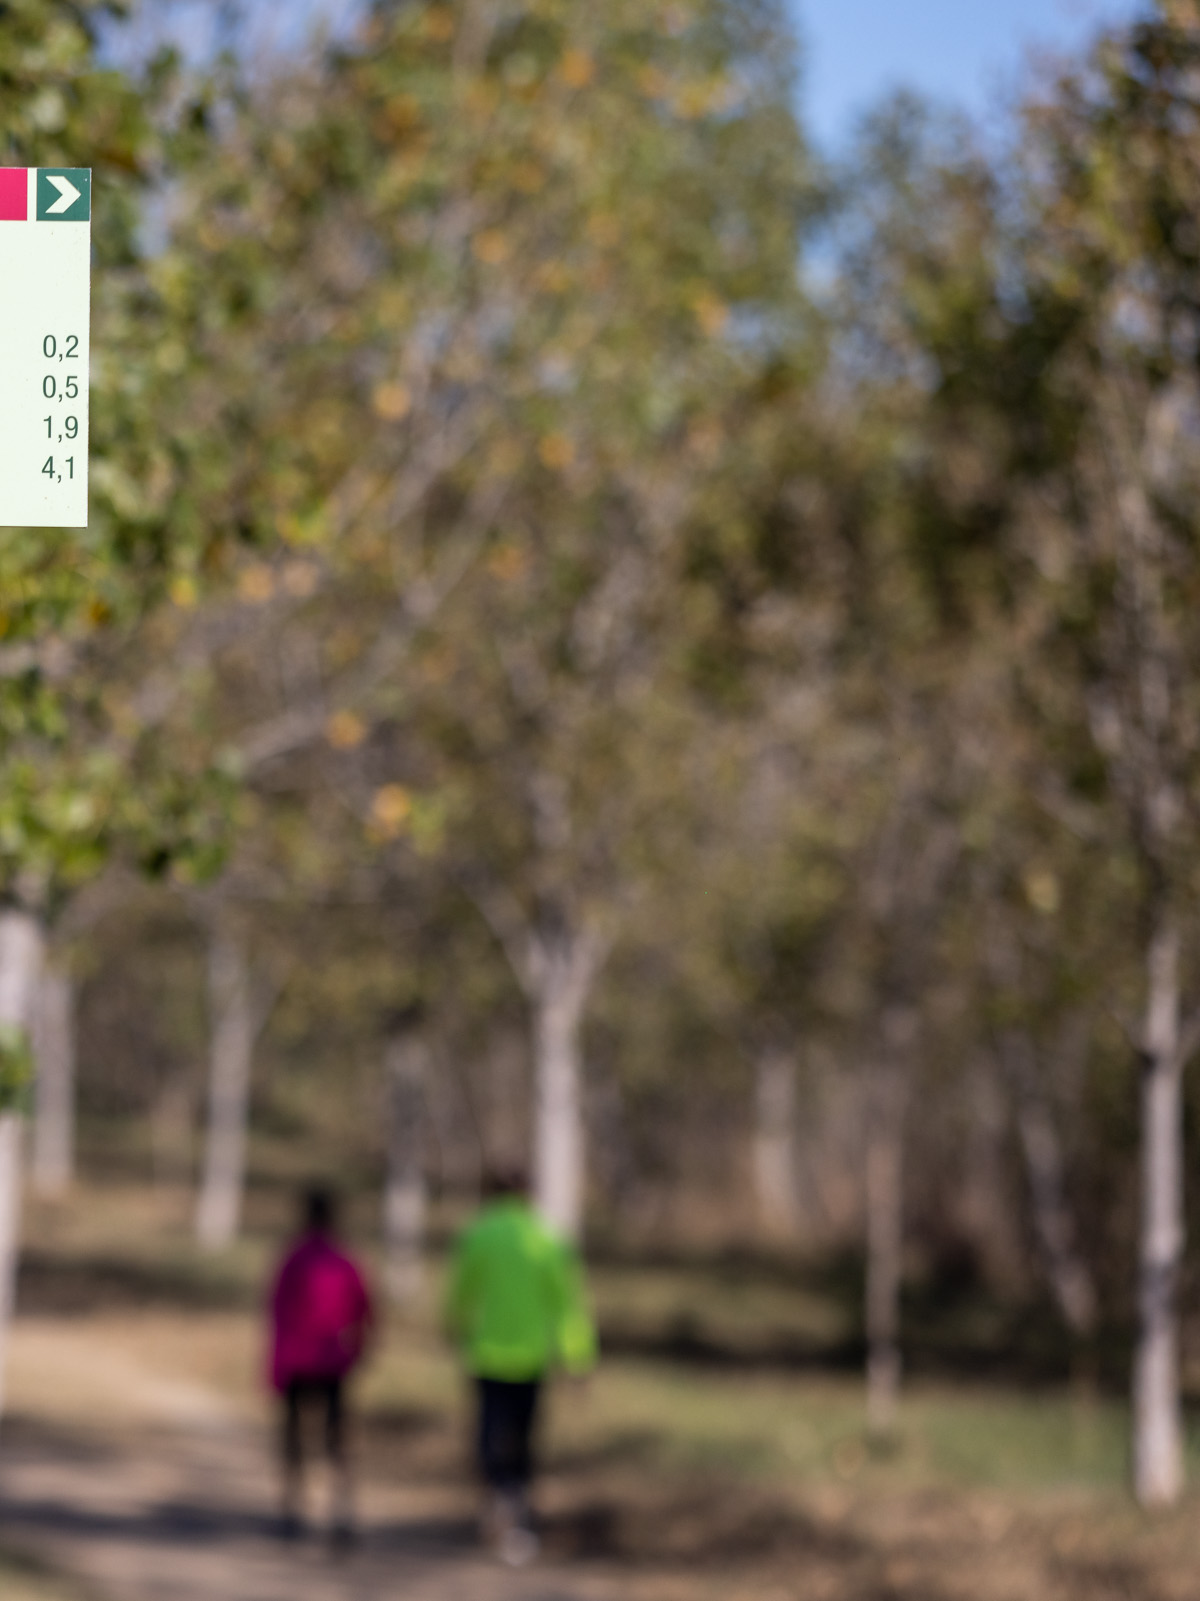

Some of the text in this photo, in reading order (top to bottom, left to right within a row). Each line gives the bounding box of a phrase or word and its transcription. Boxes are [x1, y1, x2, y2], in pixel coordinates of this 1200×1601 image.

[43, 335, 78, 362] 0,2
[43, 375, 78, 402] 0,5
[44, 416, 78, 442] 1,9
[42, 456, 75, 483] 4,1
